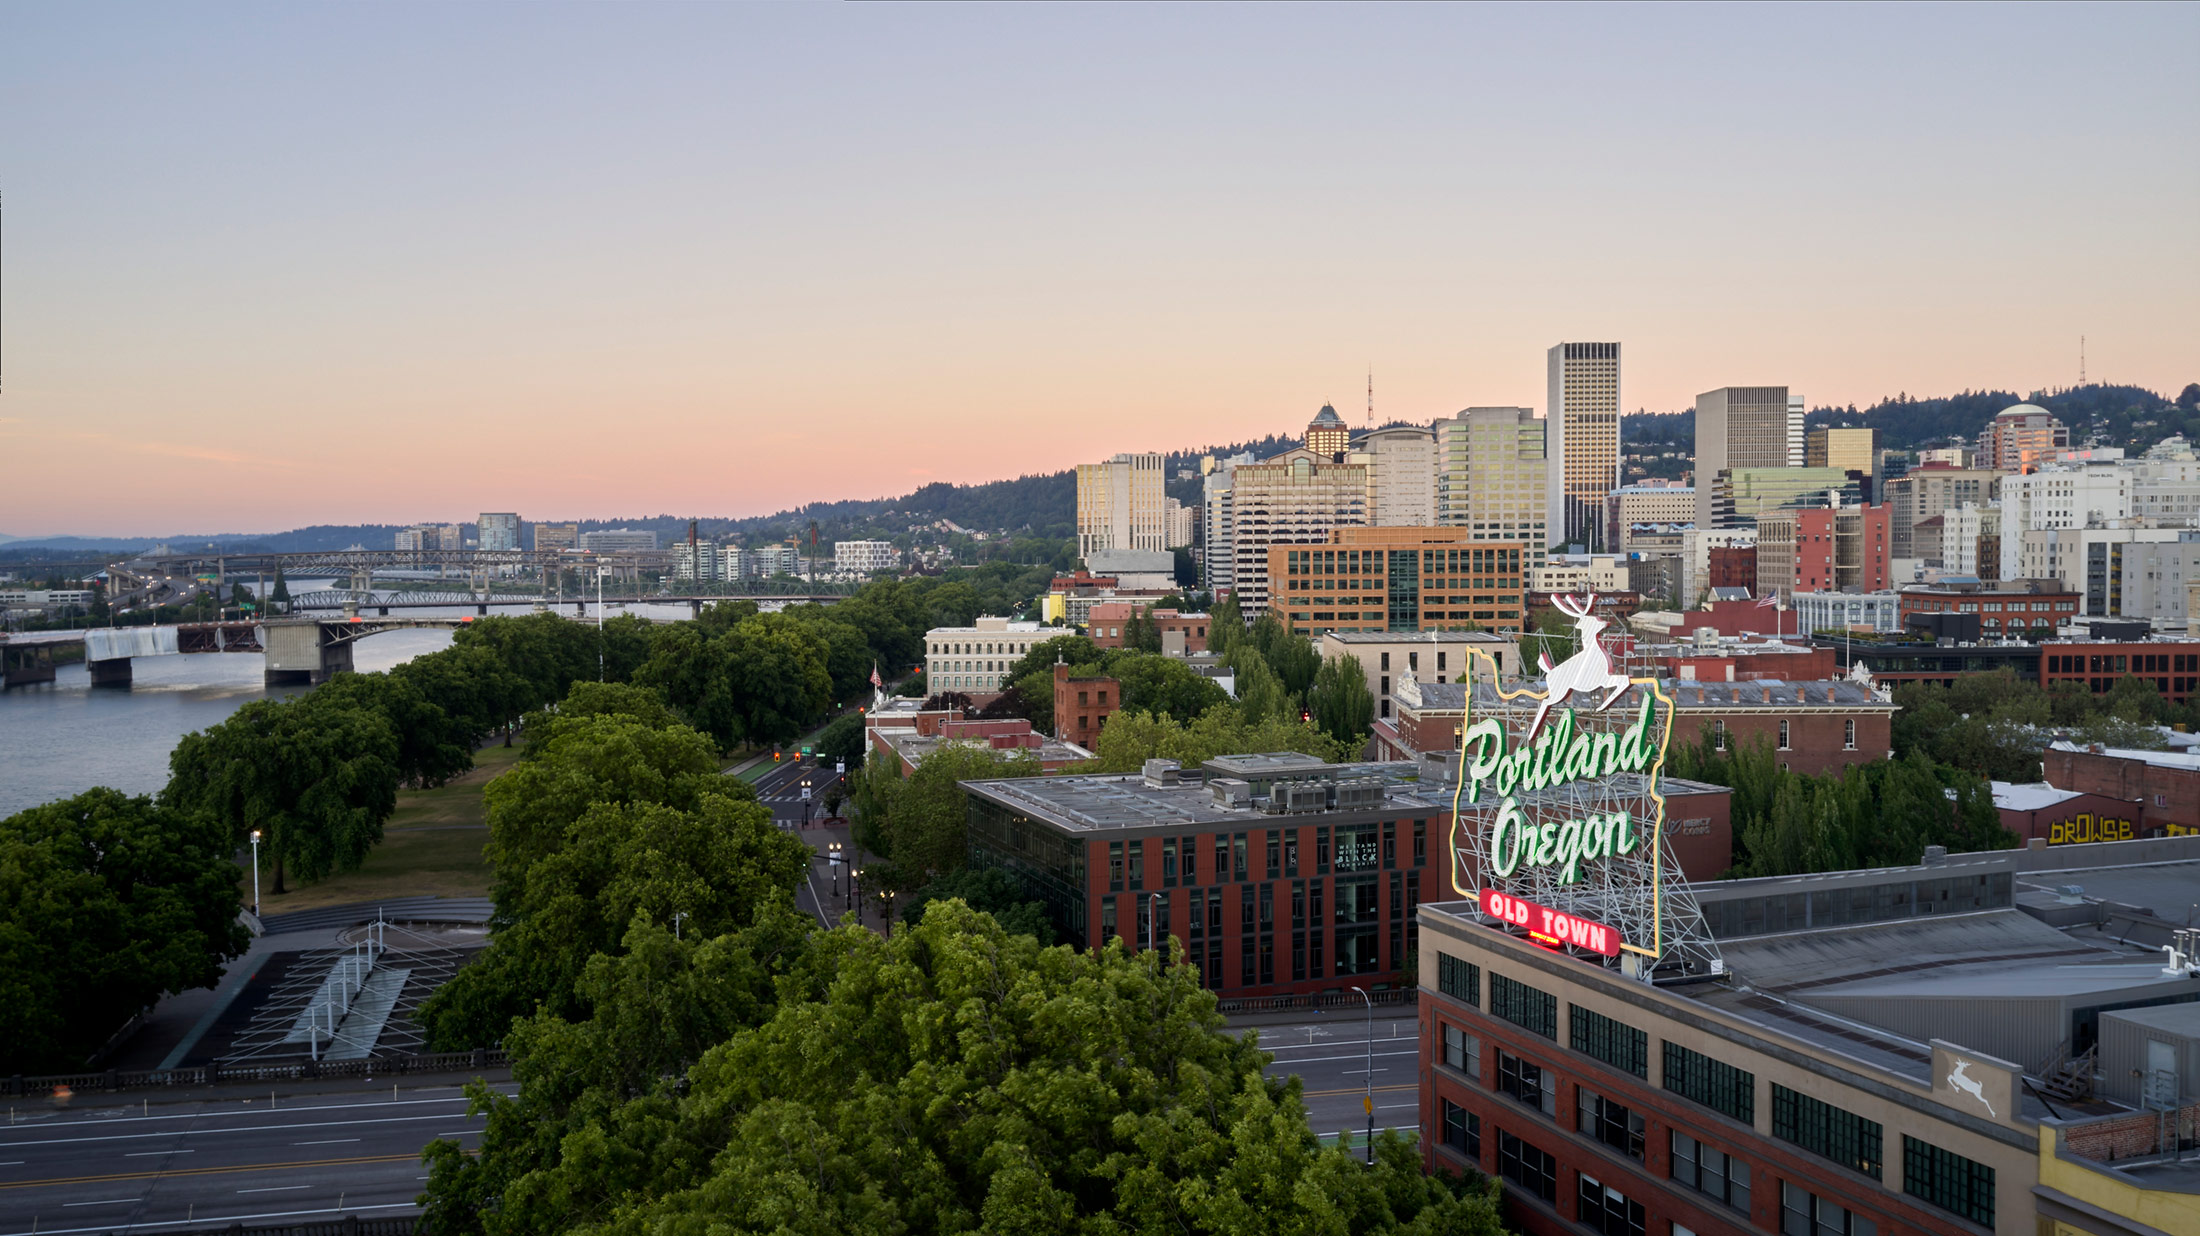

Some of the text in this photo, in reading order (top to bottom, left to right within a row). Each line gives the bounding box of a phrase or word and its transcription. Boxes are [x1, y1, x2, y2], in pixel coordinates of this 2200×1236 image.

[1465, 691, 1656, 804] Portland
[1338, 853, 1376, 862] BLACK
[1491, 796, 1639, 886] Oregon
[1490, 893, 1606, 952] OLD TOWN
